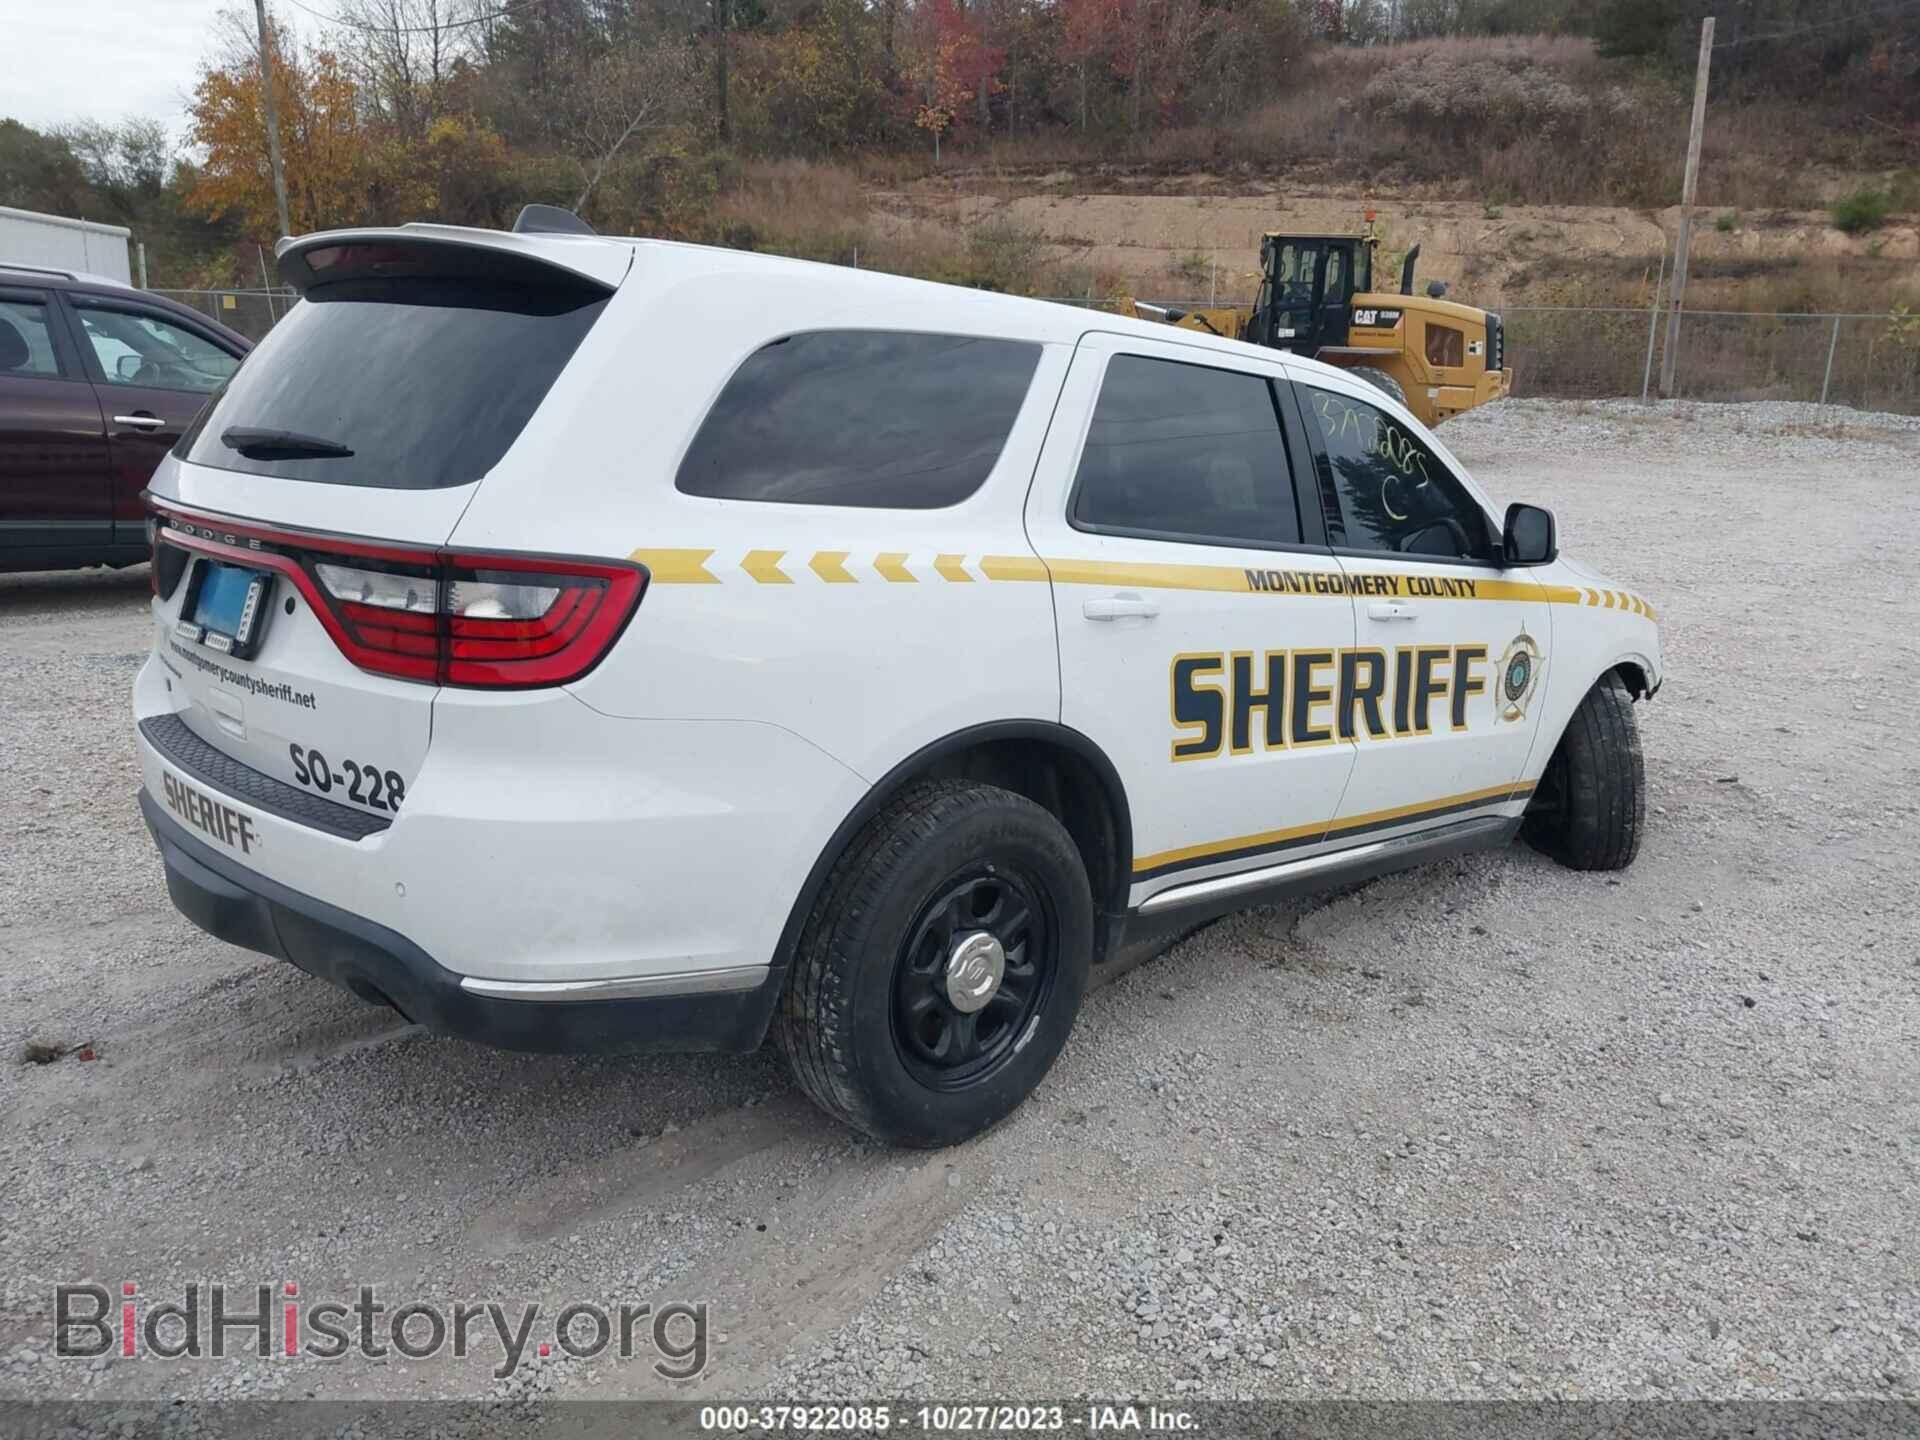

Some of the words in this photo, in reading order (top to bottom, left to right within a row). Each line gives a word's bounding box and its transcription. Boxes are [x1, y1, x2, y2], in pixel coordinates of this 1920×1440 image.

[1355, 310, 1378, 324] CAT
[168, 519, 262, 550] DODGE
[1244, 568, 1399, 597] MONTGOMERY
[1406, 575, 1477, 598] COUNTY
[1170, 643, 1489, 763] SHERIFF
[289, 742, 406, 813] SO-228
[162, 770, 255, 855] SHERIFF
